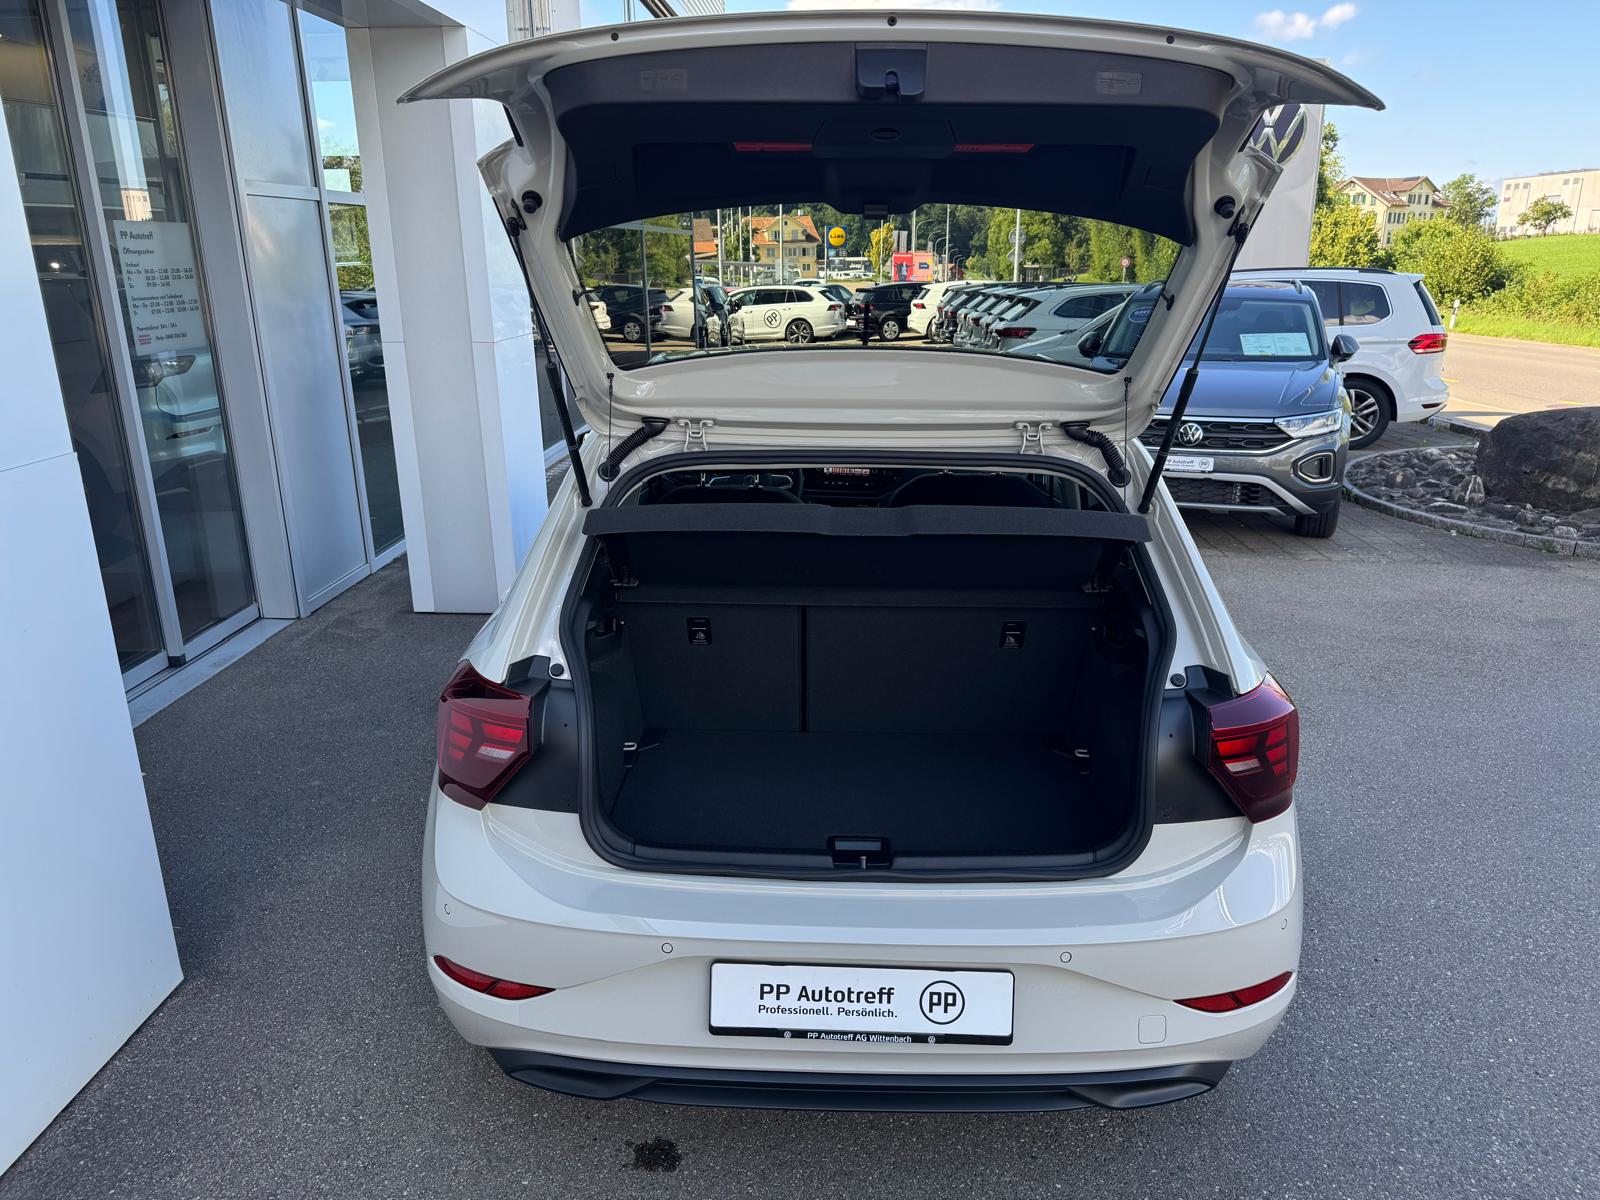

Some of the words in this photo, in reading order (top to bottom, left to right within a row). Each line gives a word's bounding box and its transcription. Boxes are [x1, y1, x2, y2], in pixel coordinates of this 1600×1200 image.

[130, 231, 153, 240] Autotreff
[766, 311, 778, 326] PP
[759, 983, 791, 1001] PP
[796, 985, 895, 1004] Autotreff
[928, 991, 957, 1014] PP
[758, 1004, 833, 1016] Professionell.
[837, 1007, 898, 1018] Persönlich.
[820, 1032, 854, 1041] Autotreff
[855, 1034, 867, 1042] AG
[869, 1034, 912, 1044] Wittenbach
